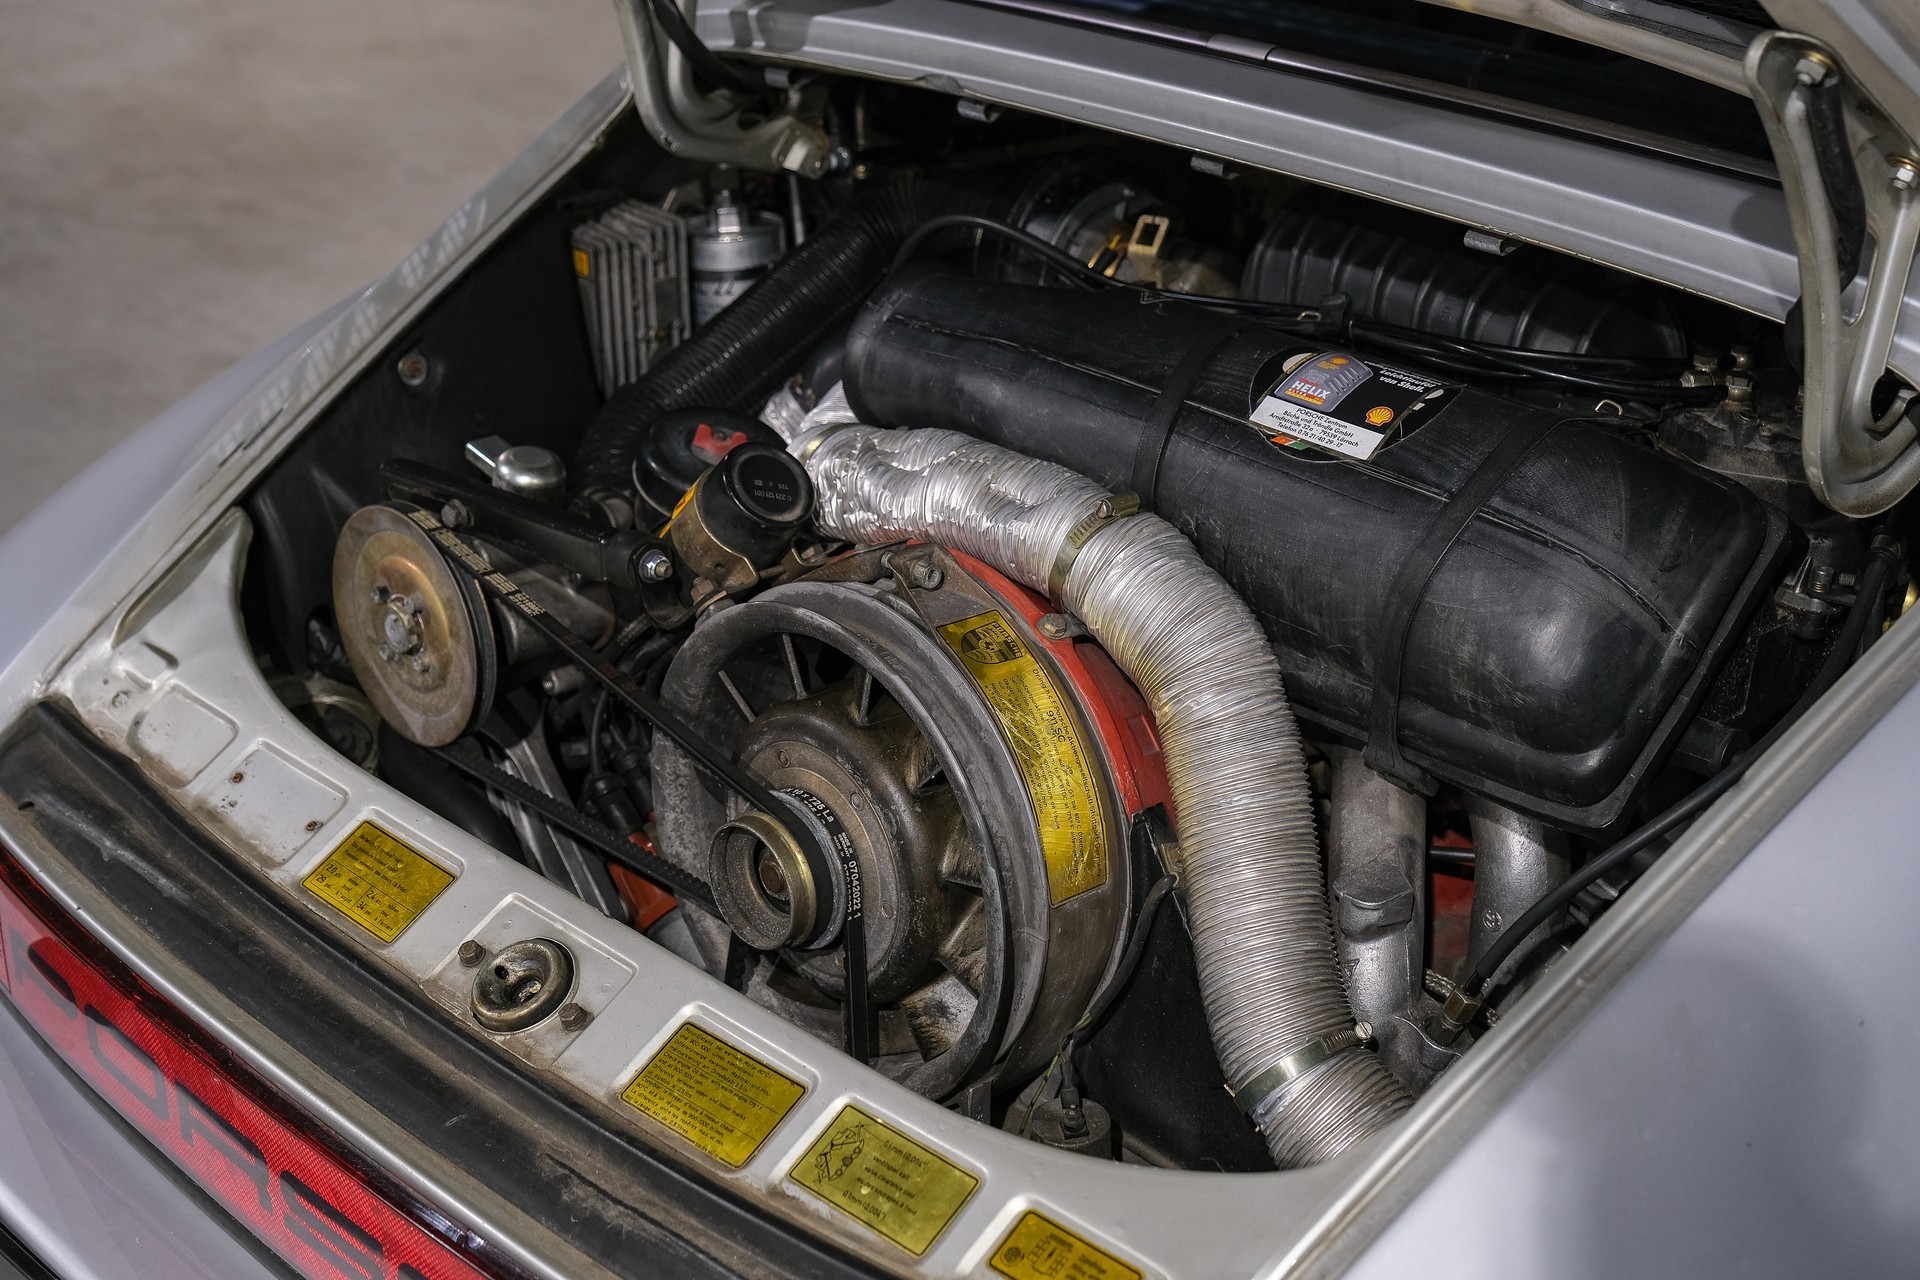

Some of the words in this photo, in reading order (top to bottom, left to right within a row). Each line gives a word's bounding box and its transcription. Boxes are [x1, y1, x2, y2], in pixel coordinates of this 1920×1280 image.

[1291, 380, 1331, 399] HELIX
[1379, 376, 1398, 385] von
[1277, 422, 1297, 432] Telefon
[1296, 407, 1325, 420] PORSCHE
[1325, 418, 1348, 429] Zentrum
[1319, 429, 1337, 439] 79539
[1334, 427, 1353, 437] GmbH
[991, 622, 1023, 658] PORSCHE
[1045, 709, 1058, 725] 911
[1053, 727, 1066, 743] SC
[1053, 705, 1071, 735] Porsche
[1066, 735, 1094, 805] Aktiengesellschaft
[808, 796, 826, 811] 725
[822, 809, 835, 823] La
[316, 874, 327, 883] 29
[848, 860, 861, 911] 07042022
[356, 900, 367, 910] 34
[658, 1057, 667, 1065] and
[663, 1051, 677, 1061] Check
[676, 1059, 691, 1070] engine
[699, 1071, 710, 1080] level
[652, 1063, 675, 1078] Difference
[676, 1077, 695, 1090] between
[8, 923, 430, 1280] PORS
[863, 1166, 878, 1177] valve
[877, 1173, 904, 1192] clearance
[903, 1188, 916, 1199] cold
